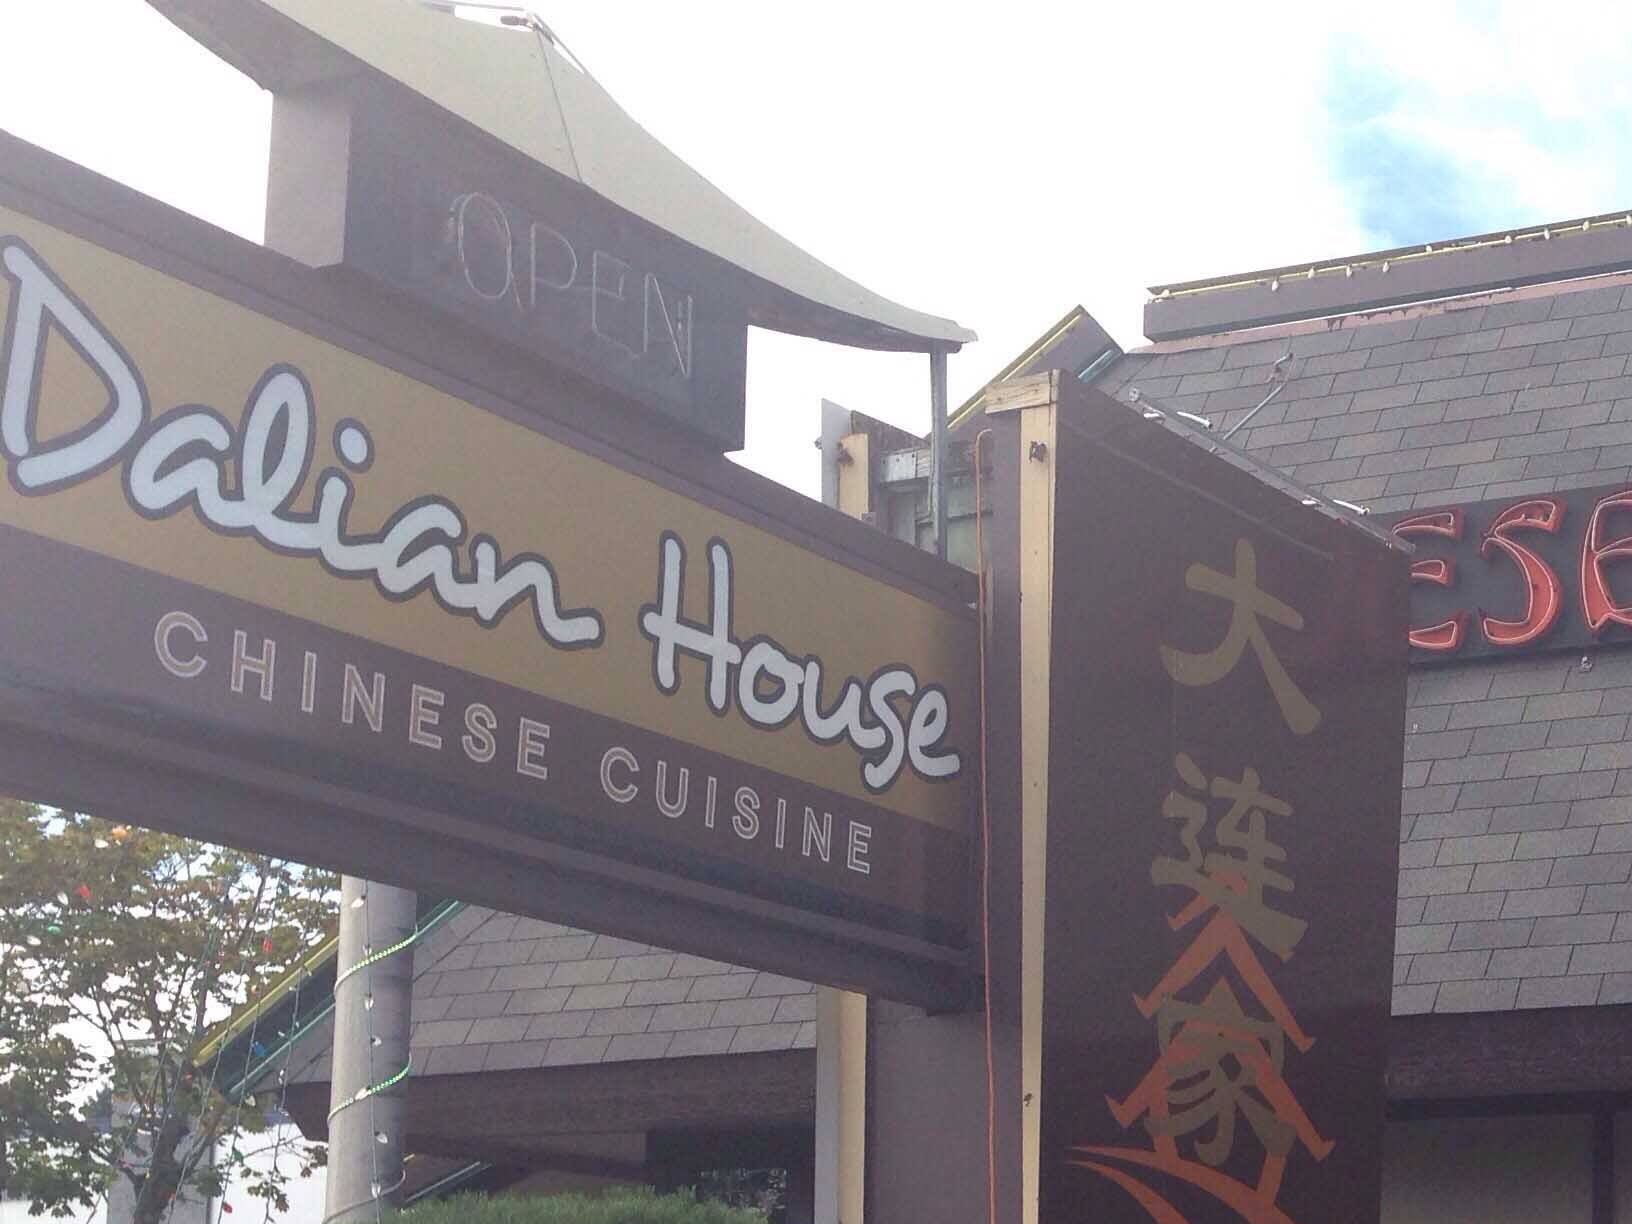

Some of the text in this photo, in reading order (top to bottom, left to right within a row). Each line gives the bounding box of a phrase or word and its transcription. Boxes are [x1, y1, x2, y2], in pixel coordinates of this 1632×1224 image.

[450, 189, 695, 380] OPEN
[0, 234, 962, 792] Dalian House
[153, 610, 873, 876] CHINESE CUISINE
